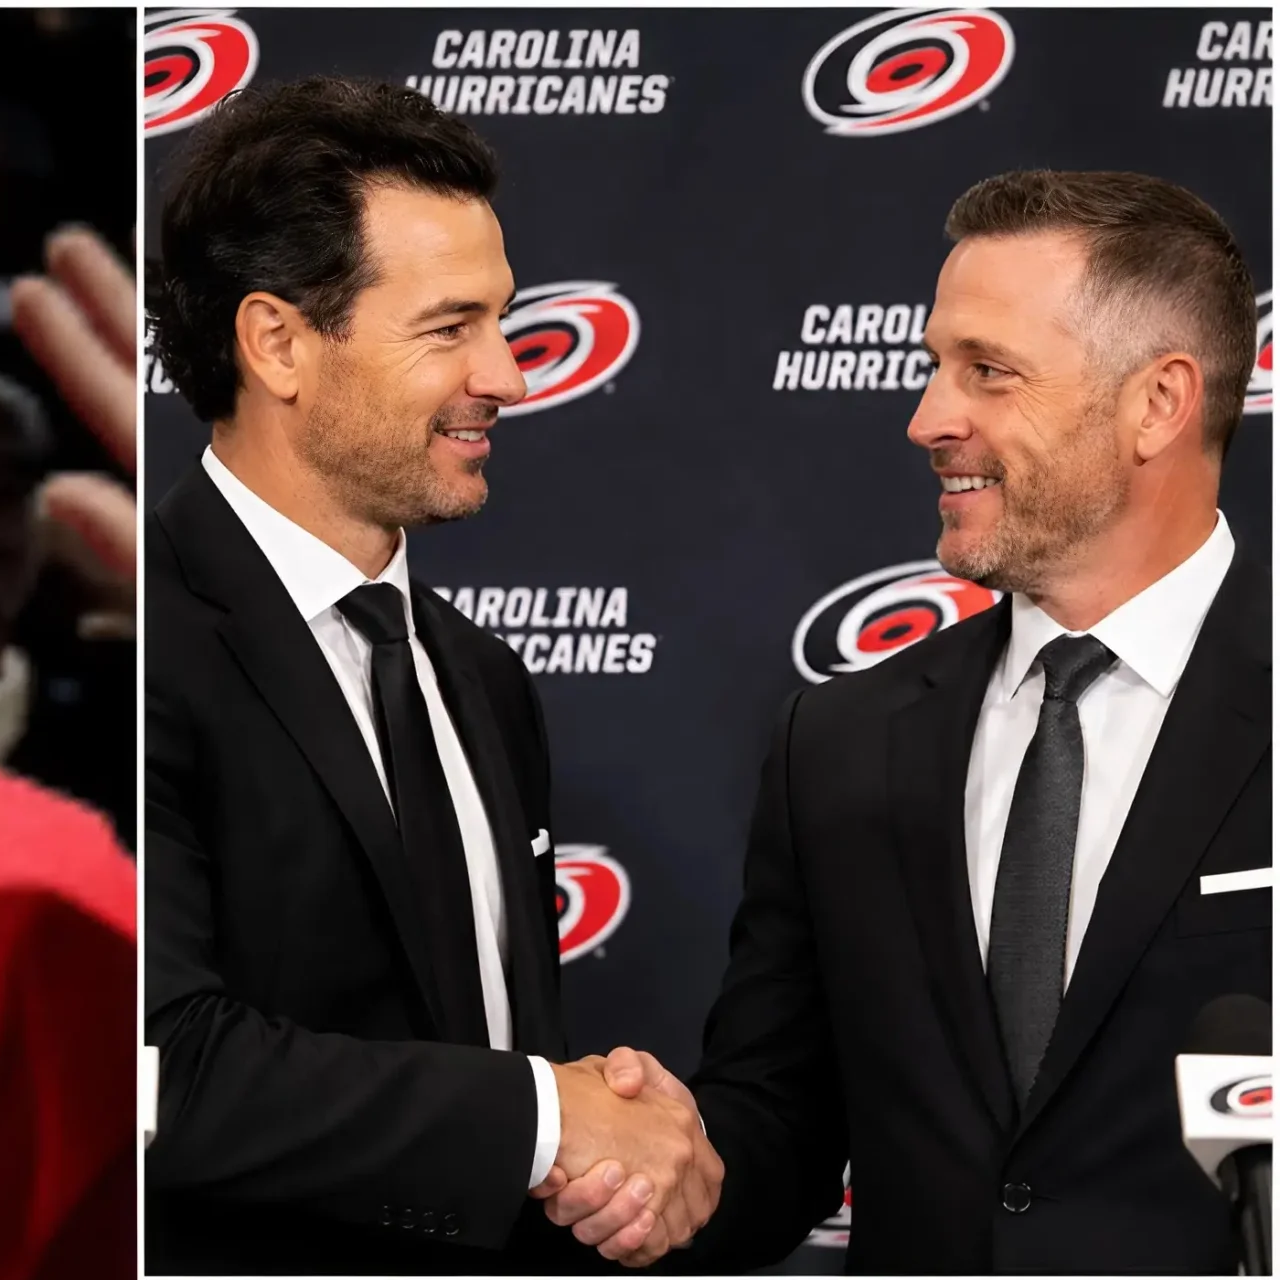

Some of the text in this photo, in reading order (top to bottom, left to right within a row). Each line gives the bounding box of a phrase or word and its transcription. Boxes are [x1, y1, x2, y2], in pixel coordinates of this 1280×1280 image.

[432, 29, 640, 69] CAROLINA
[405, 74, 669, 114] URRICANES
[494, 633, 656, 673] CANES
